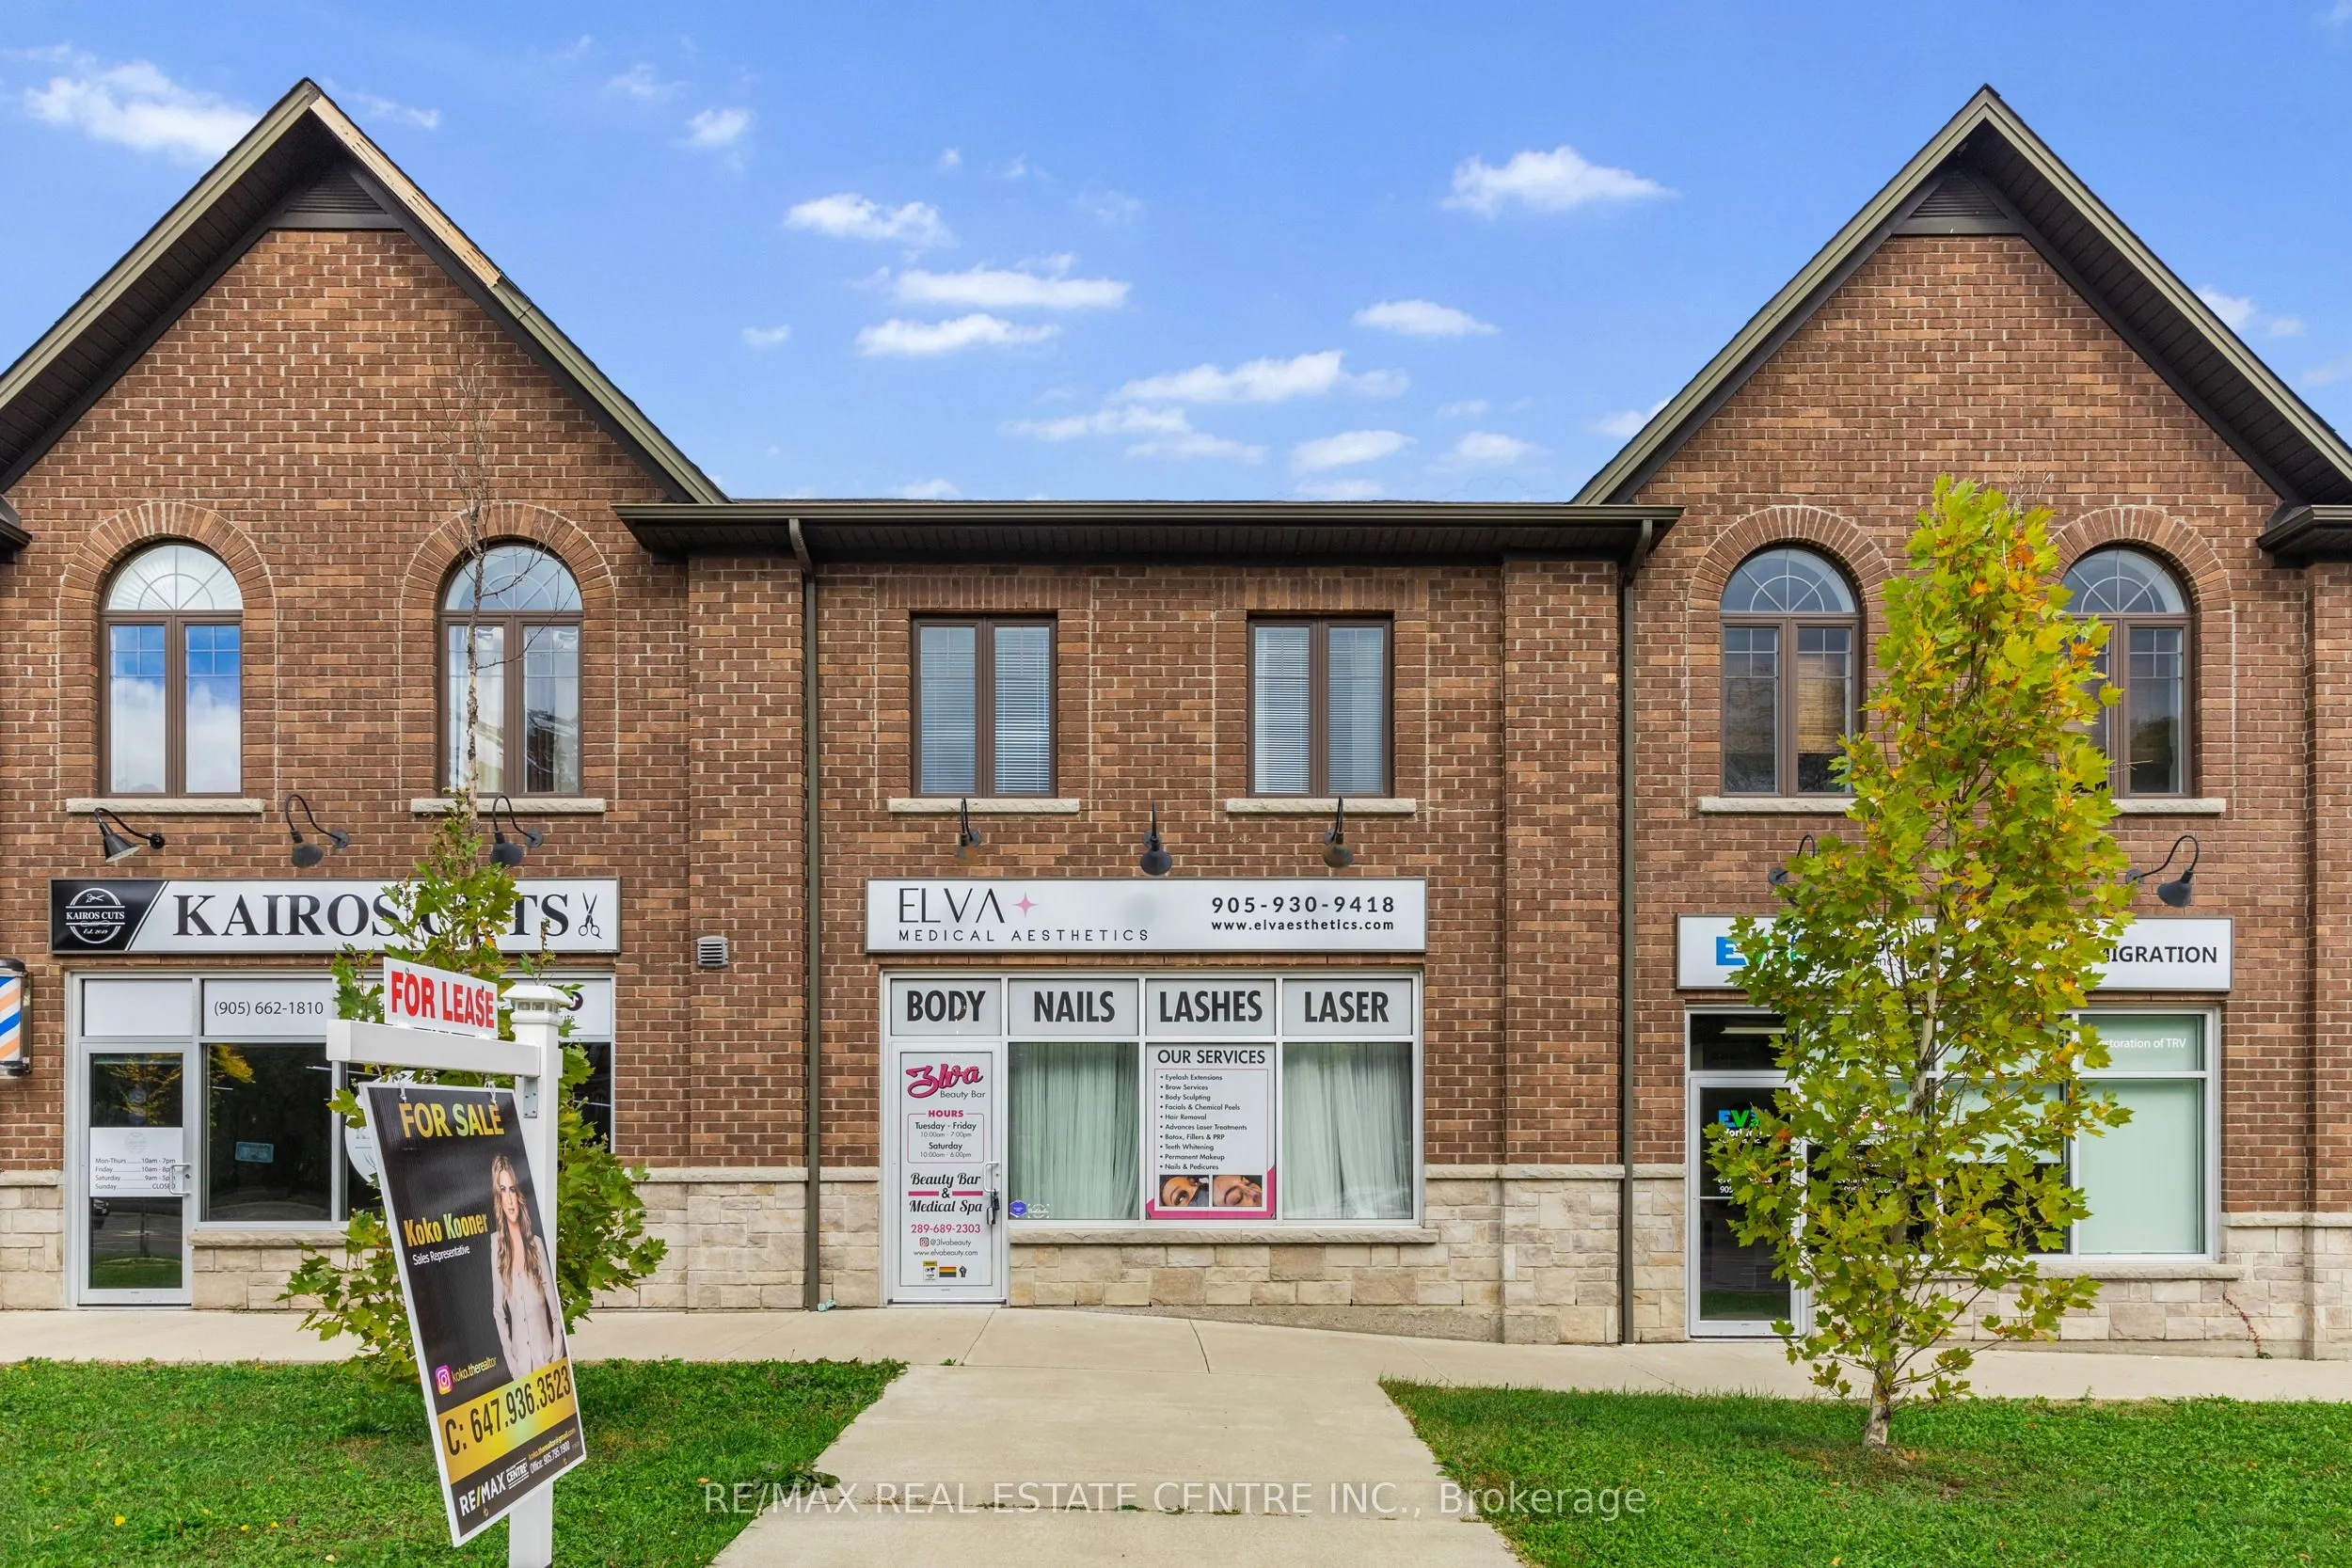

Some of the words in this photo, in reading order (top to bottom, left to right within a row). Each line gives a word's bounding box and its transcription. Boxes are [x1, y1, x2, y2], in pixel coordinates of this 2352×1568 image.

[899, 888, 1005, 923] ELVA
[1212, 896, 1394, 913] 905-930-9418
[66, 911, 100, 920] KAIROS
[101, 911, 125, 920] CUTS
[173, 894, 401, 937] KAIROS
[420, 894, 569, 937] TS
[1211, 919, 1394, 930] www.elvaesthetics.com
[898, 929, 994, 942] MEDICAL
[1011, 929, 1149, 942] AESTHETICS
[2079, 945, 2217, 963] IGRATION
[391, 971, 436, 1019] FOR
[441, 981, 495, 1028] LEASE
[907, 990, 986, 1022] BODY
[1034, 990, 1116, 1023] NAILS
[1159, 990, 1263, 1023] LASHES
[1305, 990, 1390, 1023] LASER
[215, 1001, 251, 1017] (905)
[255, 1001, 324, 1015] 662-1810
[2153, 1037, 2165, 1049] of
[2167, 1038, 2186, 1049] TRV
[1157, 1049, 1192, 1064] OUR
[1197, 1049, 1265, 1064] SERVICES
[940, 1090, 969, 1100] Beauty
[399, 1102, 453, 1138] FOR
[453, 1102, 504, 1137] SALE
[915, 1121, 946, 1132] Tuesday
[952, 1121, 977, 1132] Friday
[929, 1141, 963, 1151] Saturday
[910, 1172, 954, 1189] Beauty
[957, 1172, 981, 1185] Bar
[941, 1187, 950, 1199] &
[909, 1200, 956, 1212] Medical
[960, 1200, 983, 1216] Spa
[404, 1217, 443, 1247] Koko
[443, 1213, 488, 1240] Kooner
[911, 1224, 981, 1234] 289-689-2303
[412, 1253, 430, 1266] Sales
[430, 1244, 470, 1262] Representative
[913, 1248, 978, 1258] www.elvabeauty.com
[452, 1355, 499, 1383] koko.therealtor
[445, 1418, 468, 1456] C:
[470, 1366, 571, 1443] 647.936.3523
[507, 1462, 528, 1483] CENTRE
[459, 1472, 506, 1516] RE/MAX
